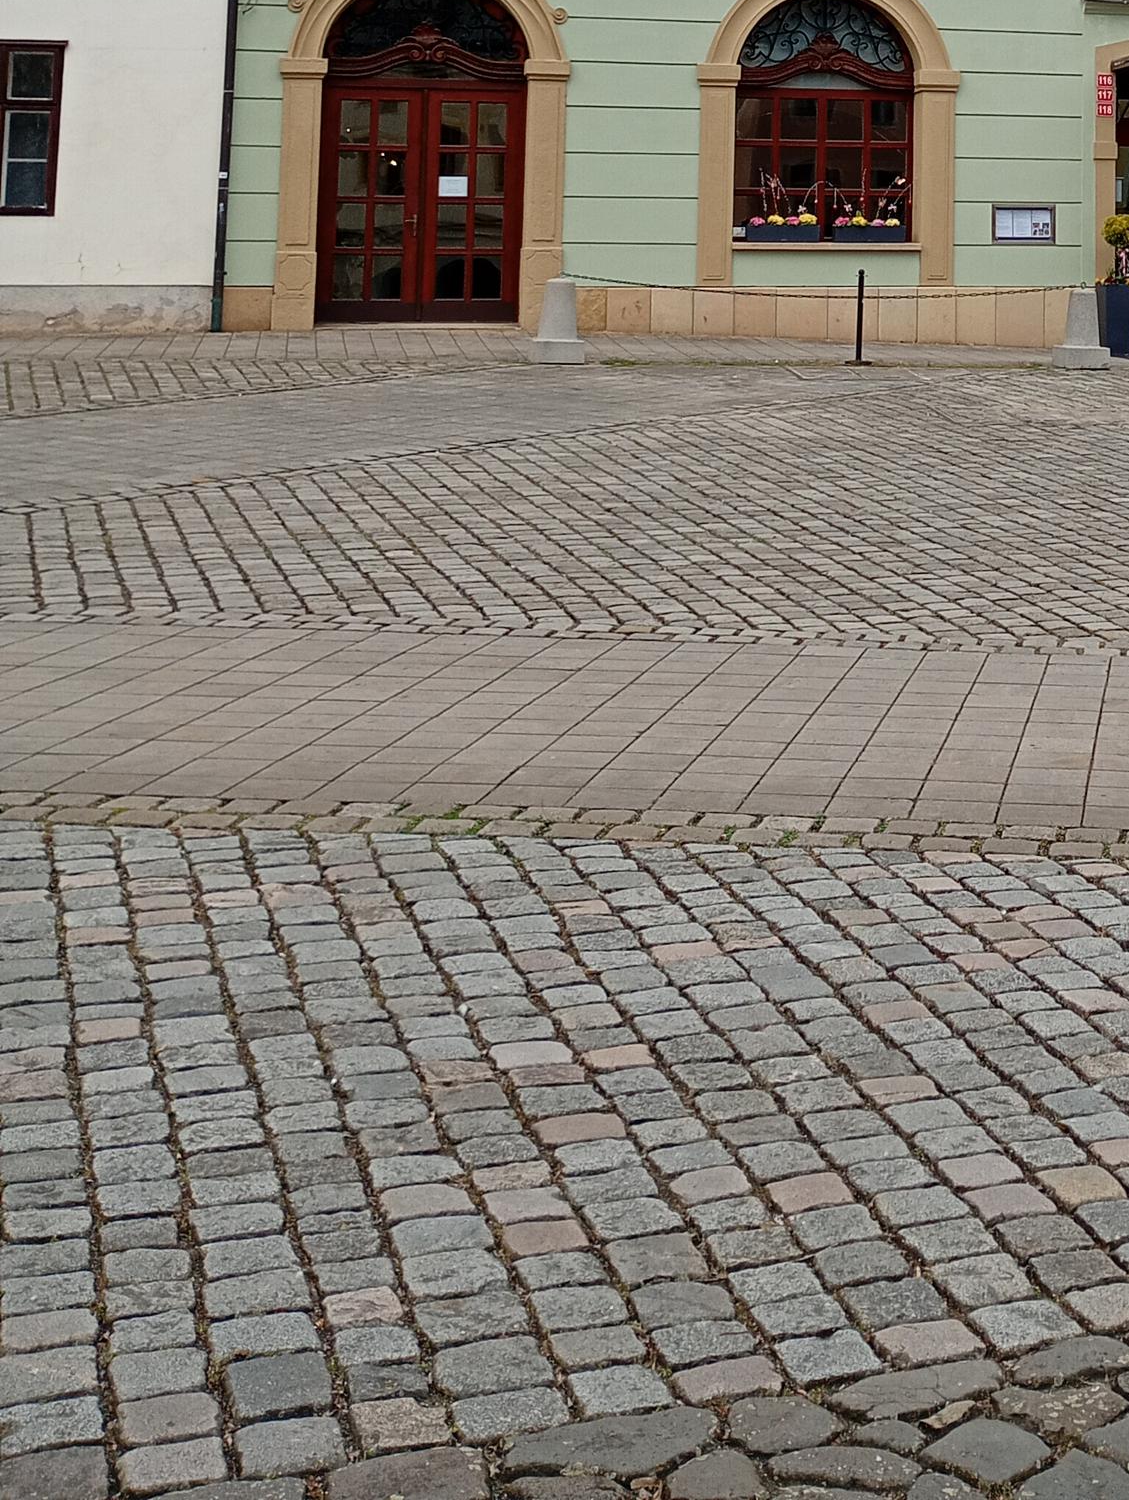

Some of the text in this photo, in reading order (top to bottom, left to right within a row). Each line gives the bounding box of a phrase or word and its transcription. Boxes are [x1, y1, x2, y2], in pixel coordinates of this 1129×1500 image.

[1099, 76, 1112, 85] 116
[1098, 91, 1112, 99] 117
[1099, 105, 1112, 114] 118
